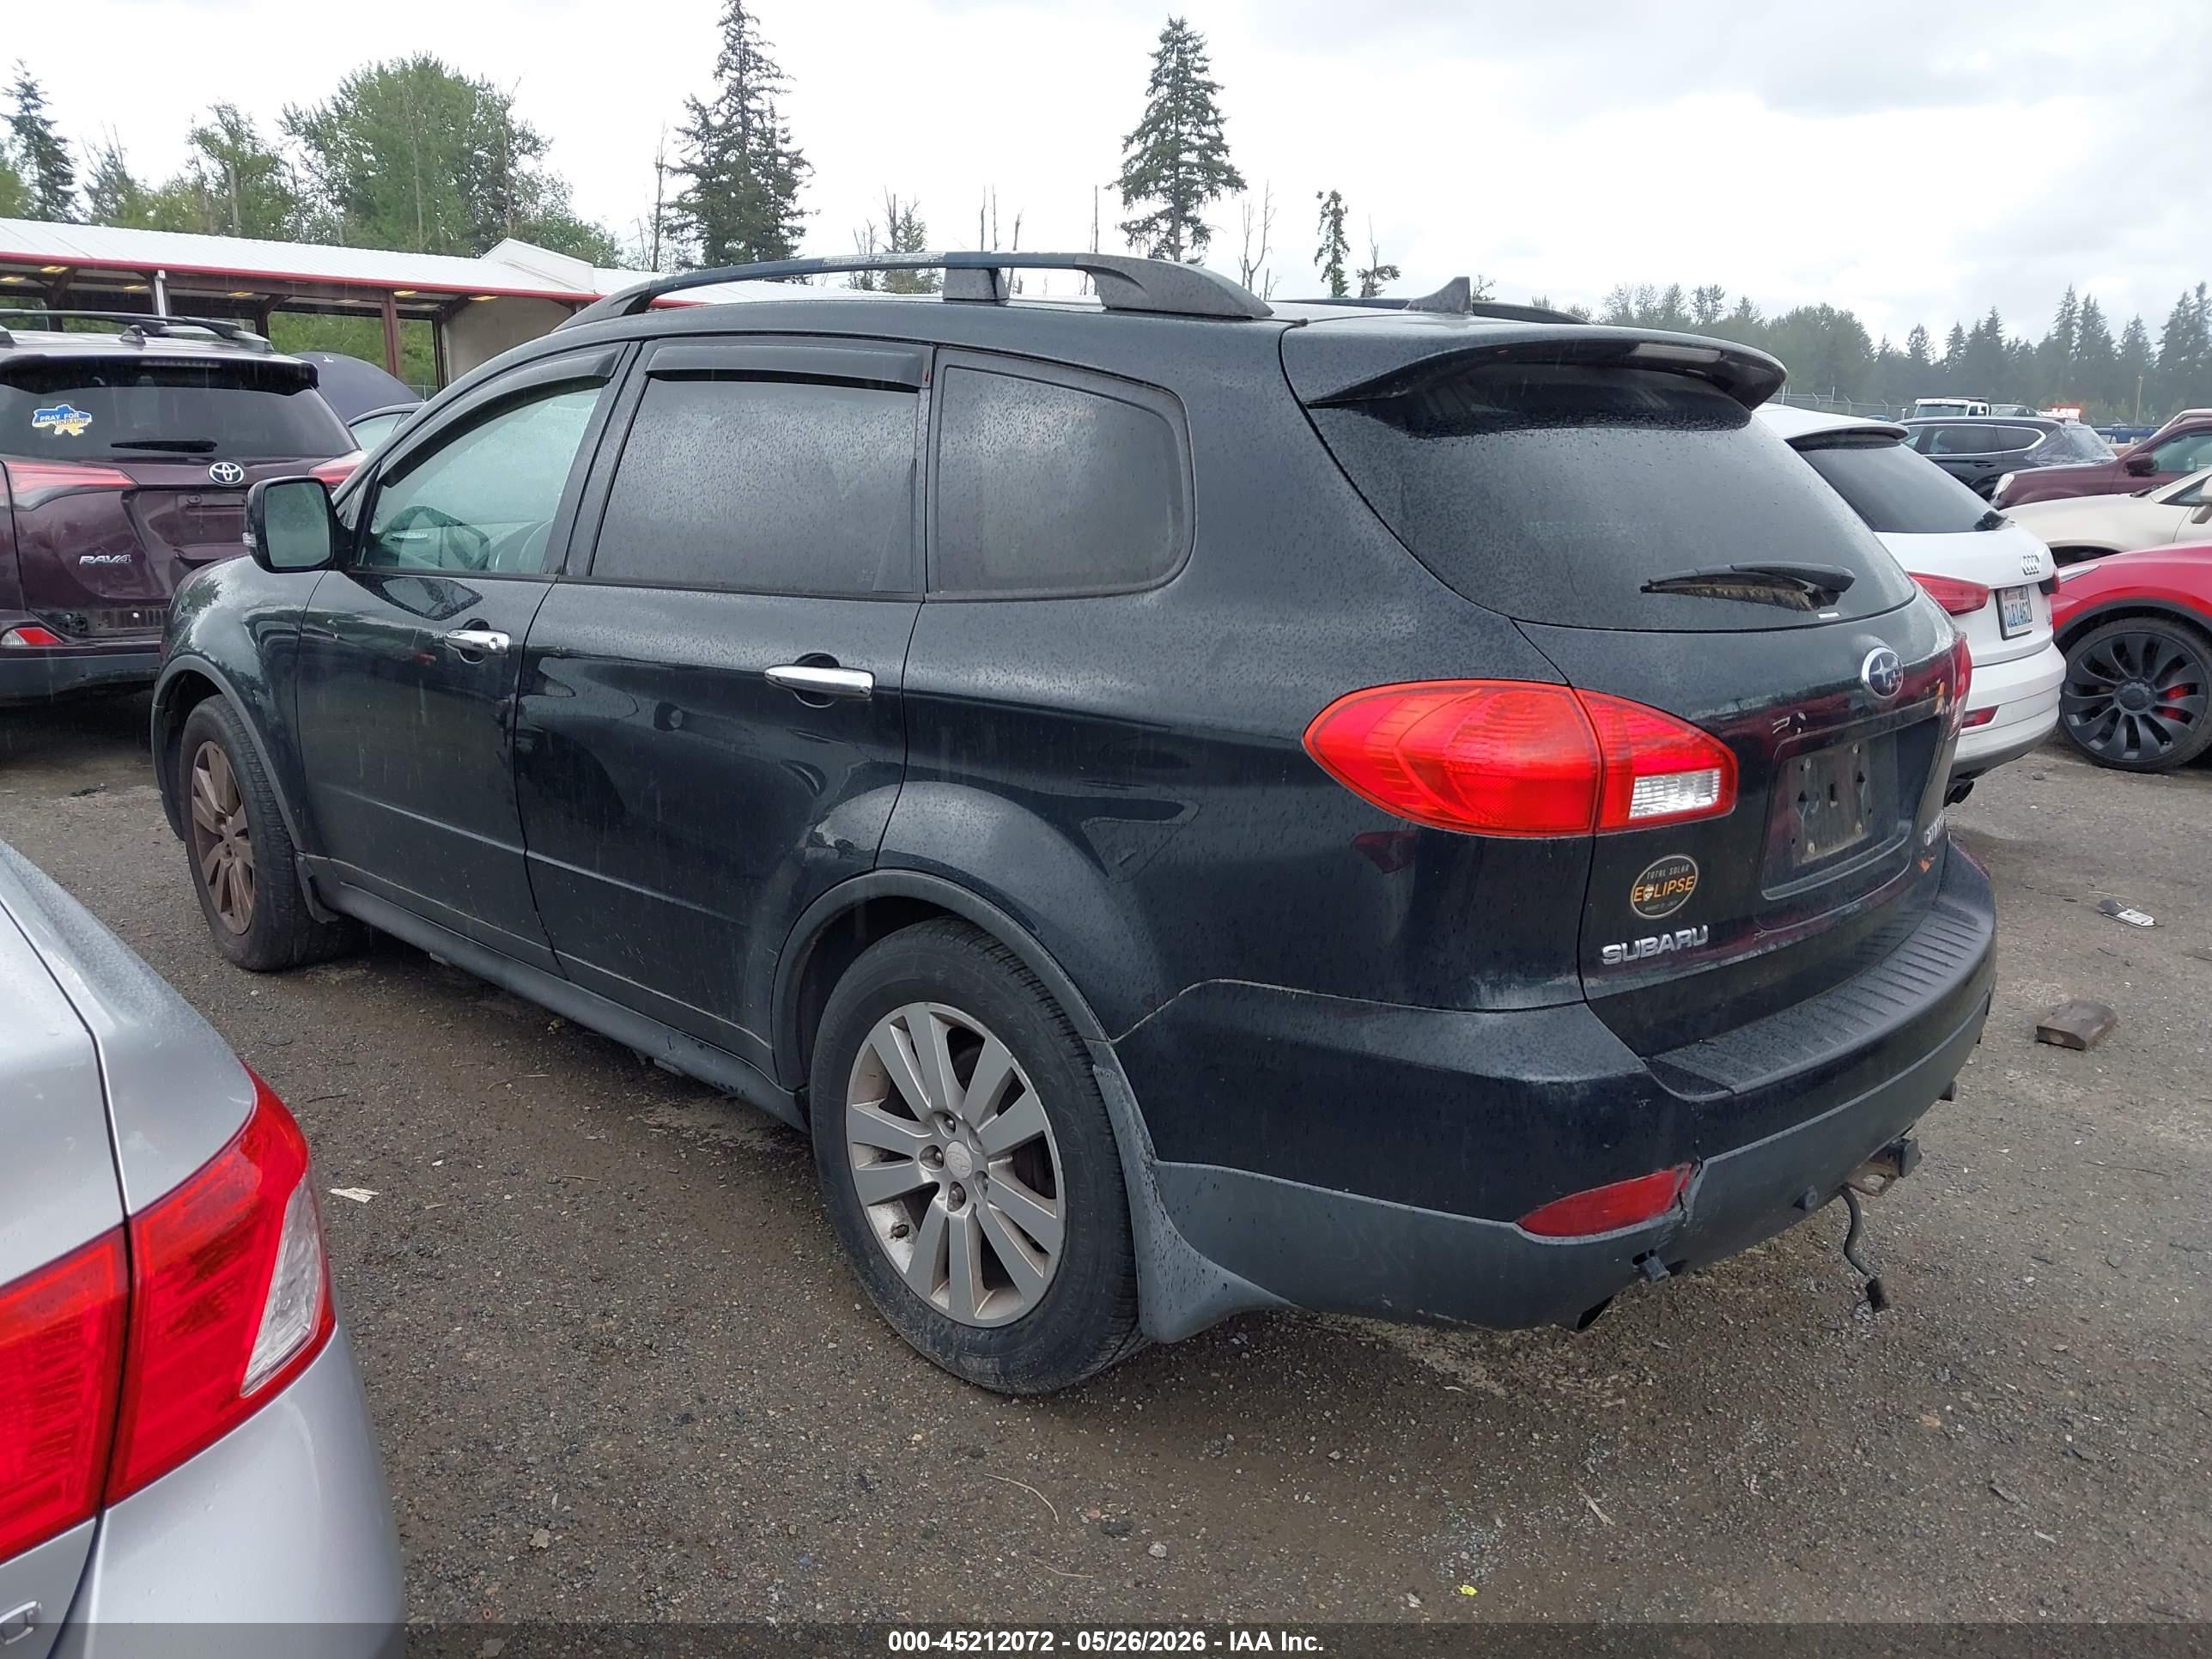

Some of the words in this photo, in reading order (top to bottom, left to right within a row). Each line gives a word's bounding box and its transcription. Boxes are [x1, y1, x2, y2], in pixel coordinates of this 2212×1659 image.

[79, 554, 131, 565] RAV4
[1646, 869, 1666, 880] TOTAL
[1669, 864, 1690, 875] SOLAR
[1601, 924, 1709, 965] SUBARU
